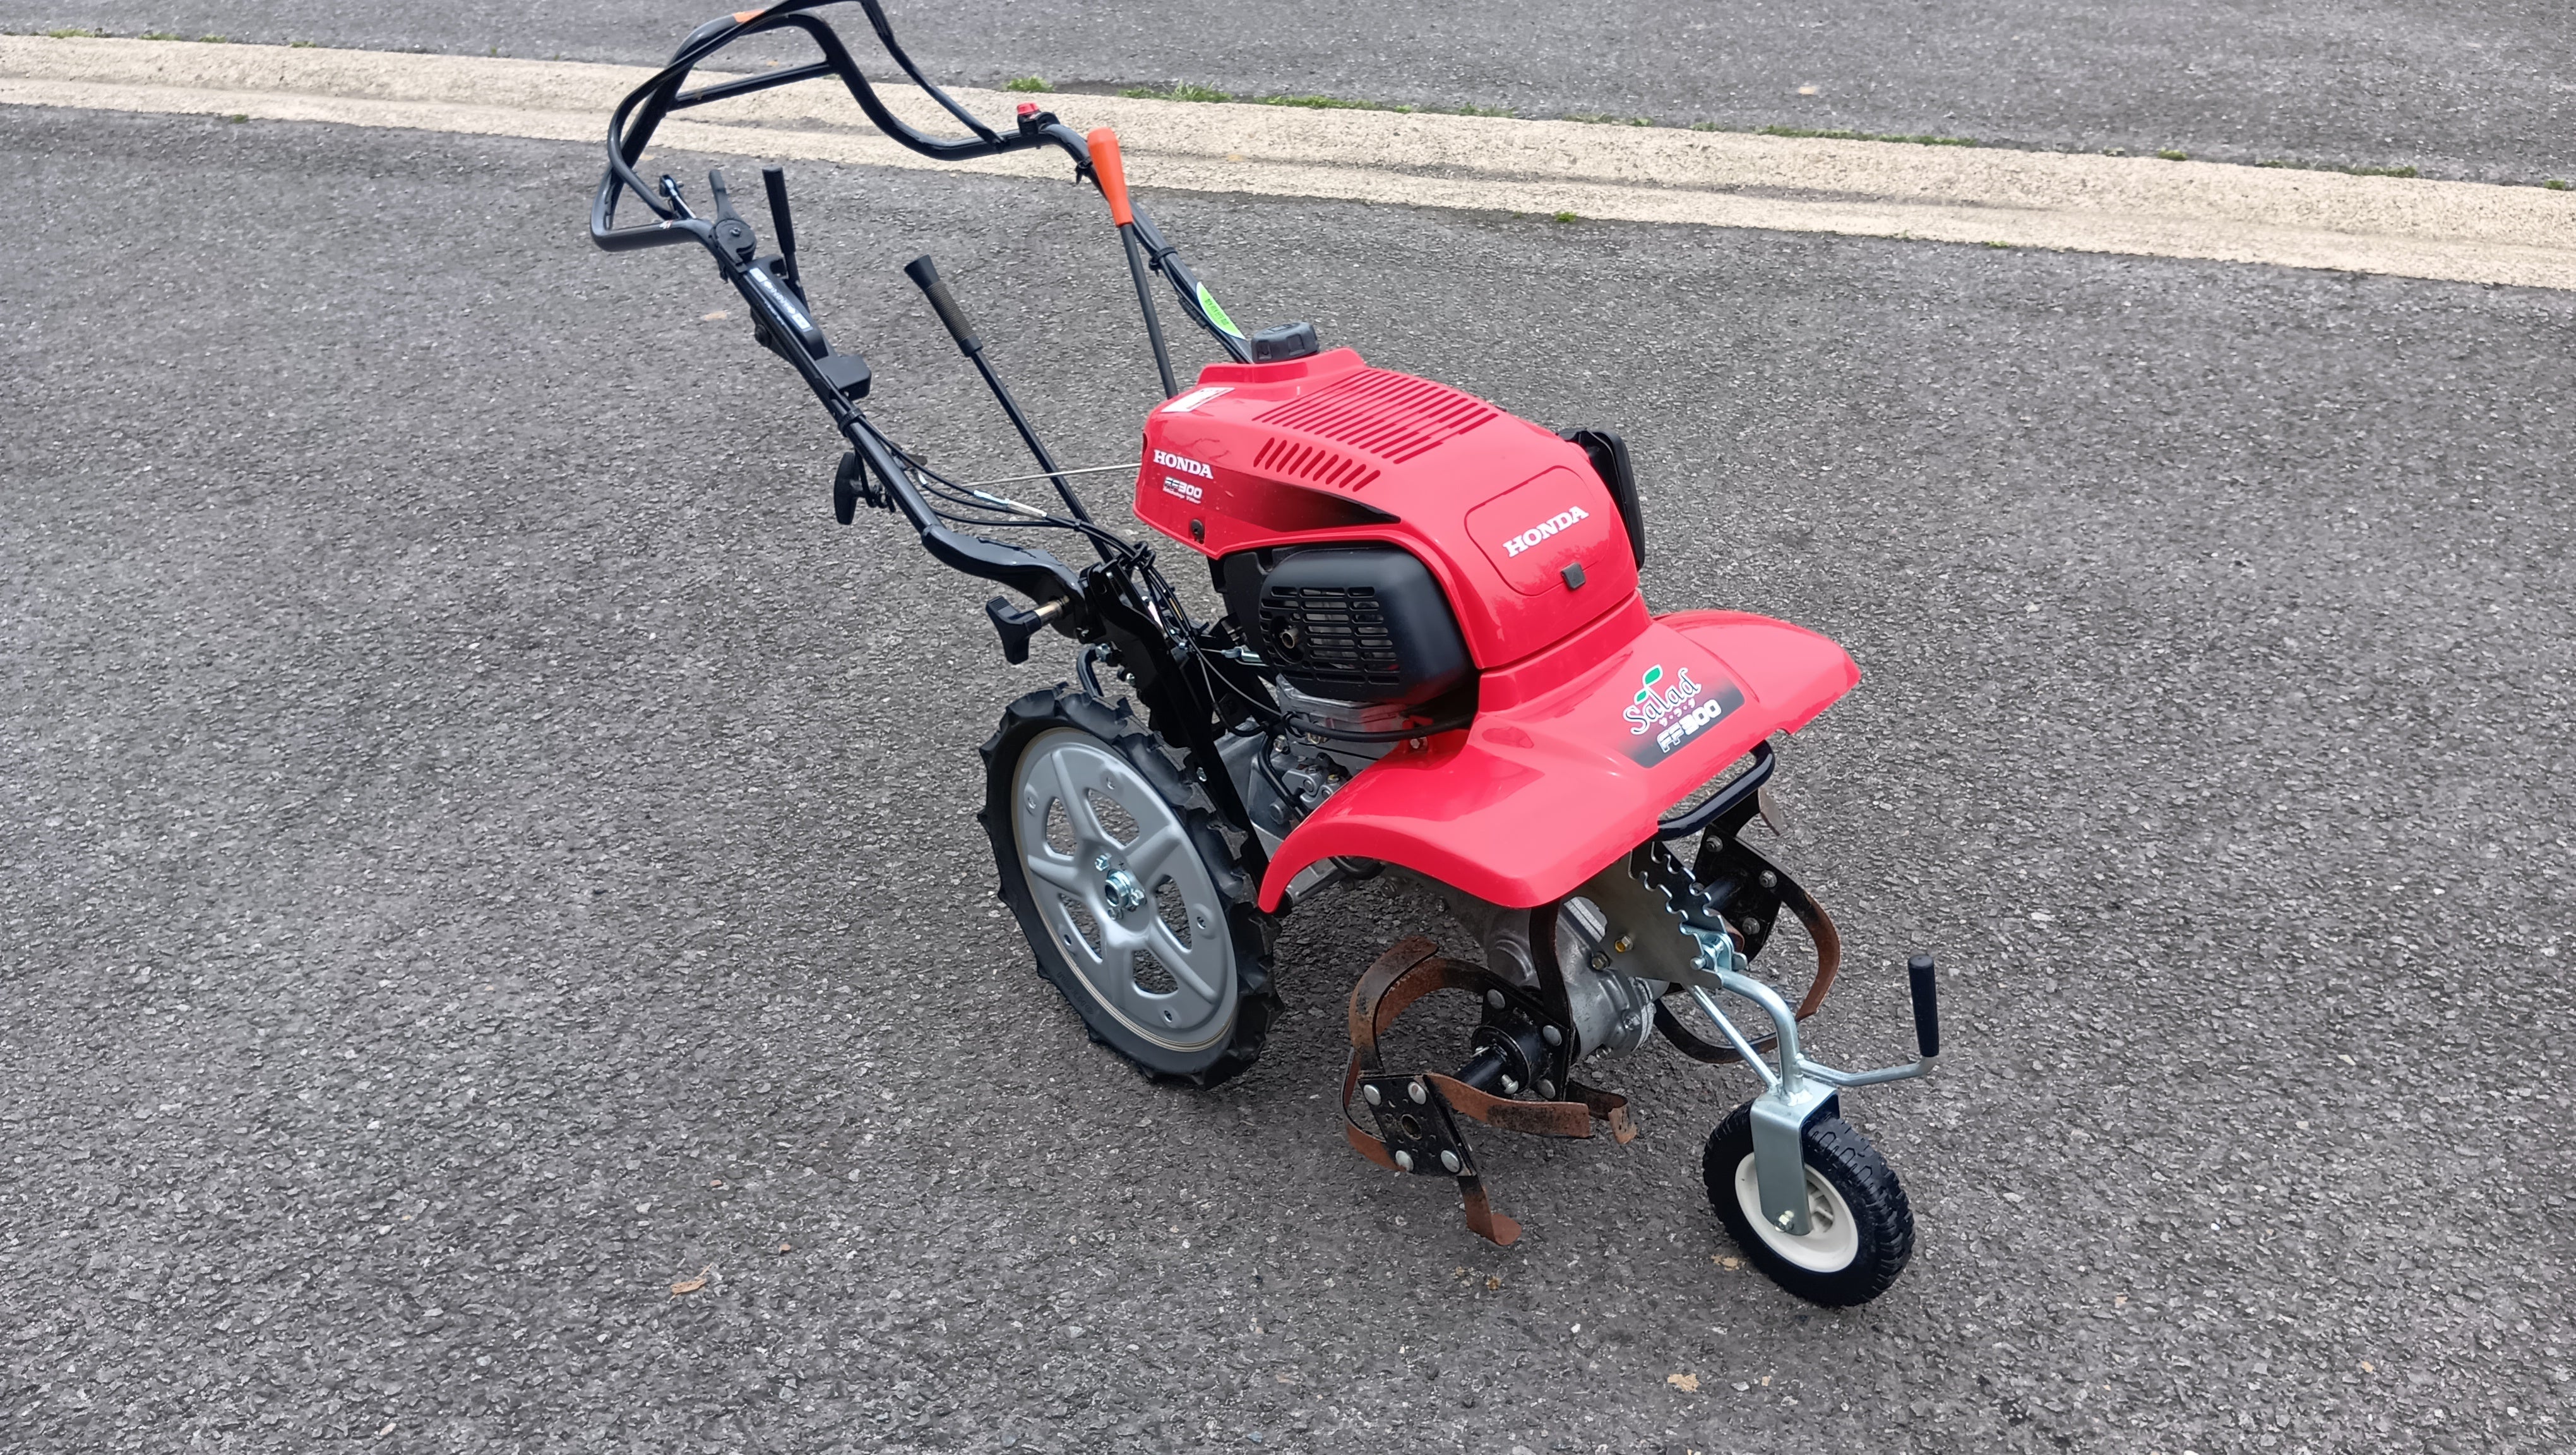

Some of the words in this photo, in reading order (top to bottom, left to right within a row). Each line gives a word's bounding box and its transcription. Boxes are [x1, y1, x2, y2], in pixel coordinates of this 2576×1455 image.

[1153, 449, 1213, 479] HONDA
[1164, 476, 1203, 499] FF300
[1502, 506, 1590, 558] HONDA
[1623, 667, 1702, 735] Salad
[1657, 699, 1722, 753] FF300
